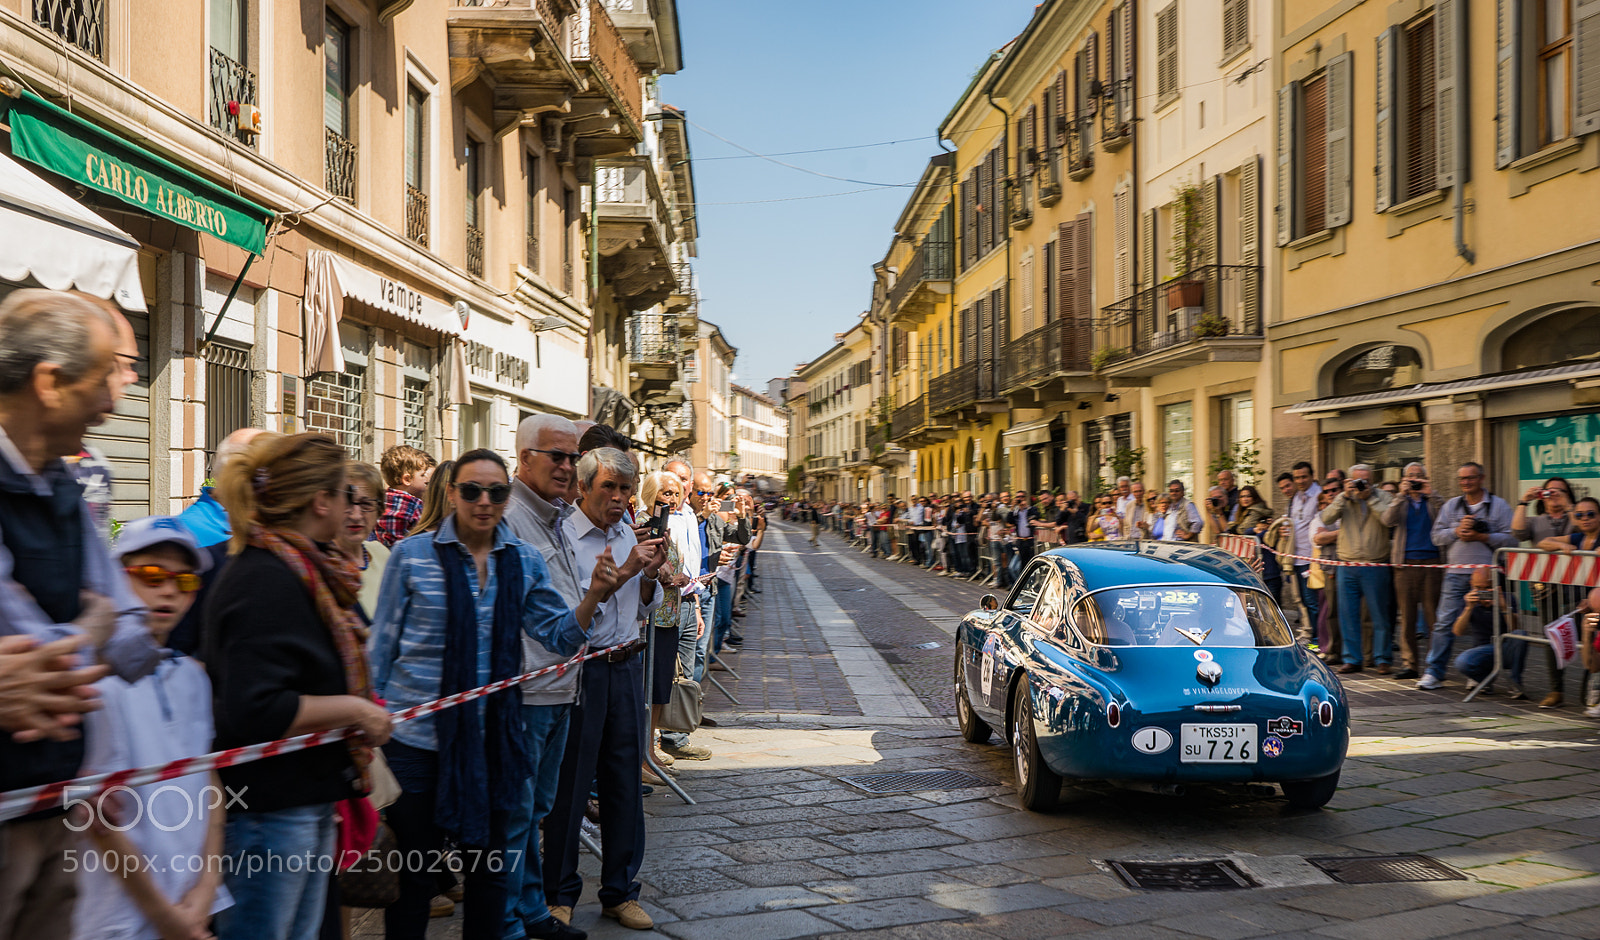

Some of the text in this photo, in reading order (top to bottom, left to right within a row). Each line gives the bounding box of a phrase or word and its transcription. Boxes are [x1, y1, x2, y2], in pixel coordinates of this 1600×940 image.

[86, 153, 227, 236] CARLO ALBERTO
[380, 277, 423, 316] vampe
[1145, 731, 1156, 750] J
[1199, 727, 1239, 738] TKS531
[1185, 745, 1201, 755] SU
[1207, 740, 1250, 760] 726
